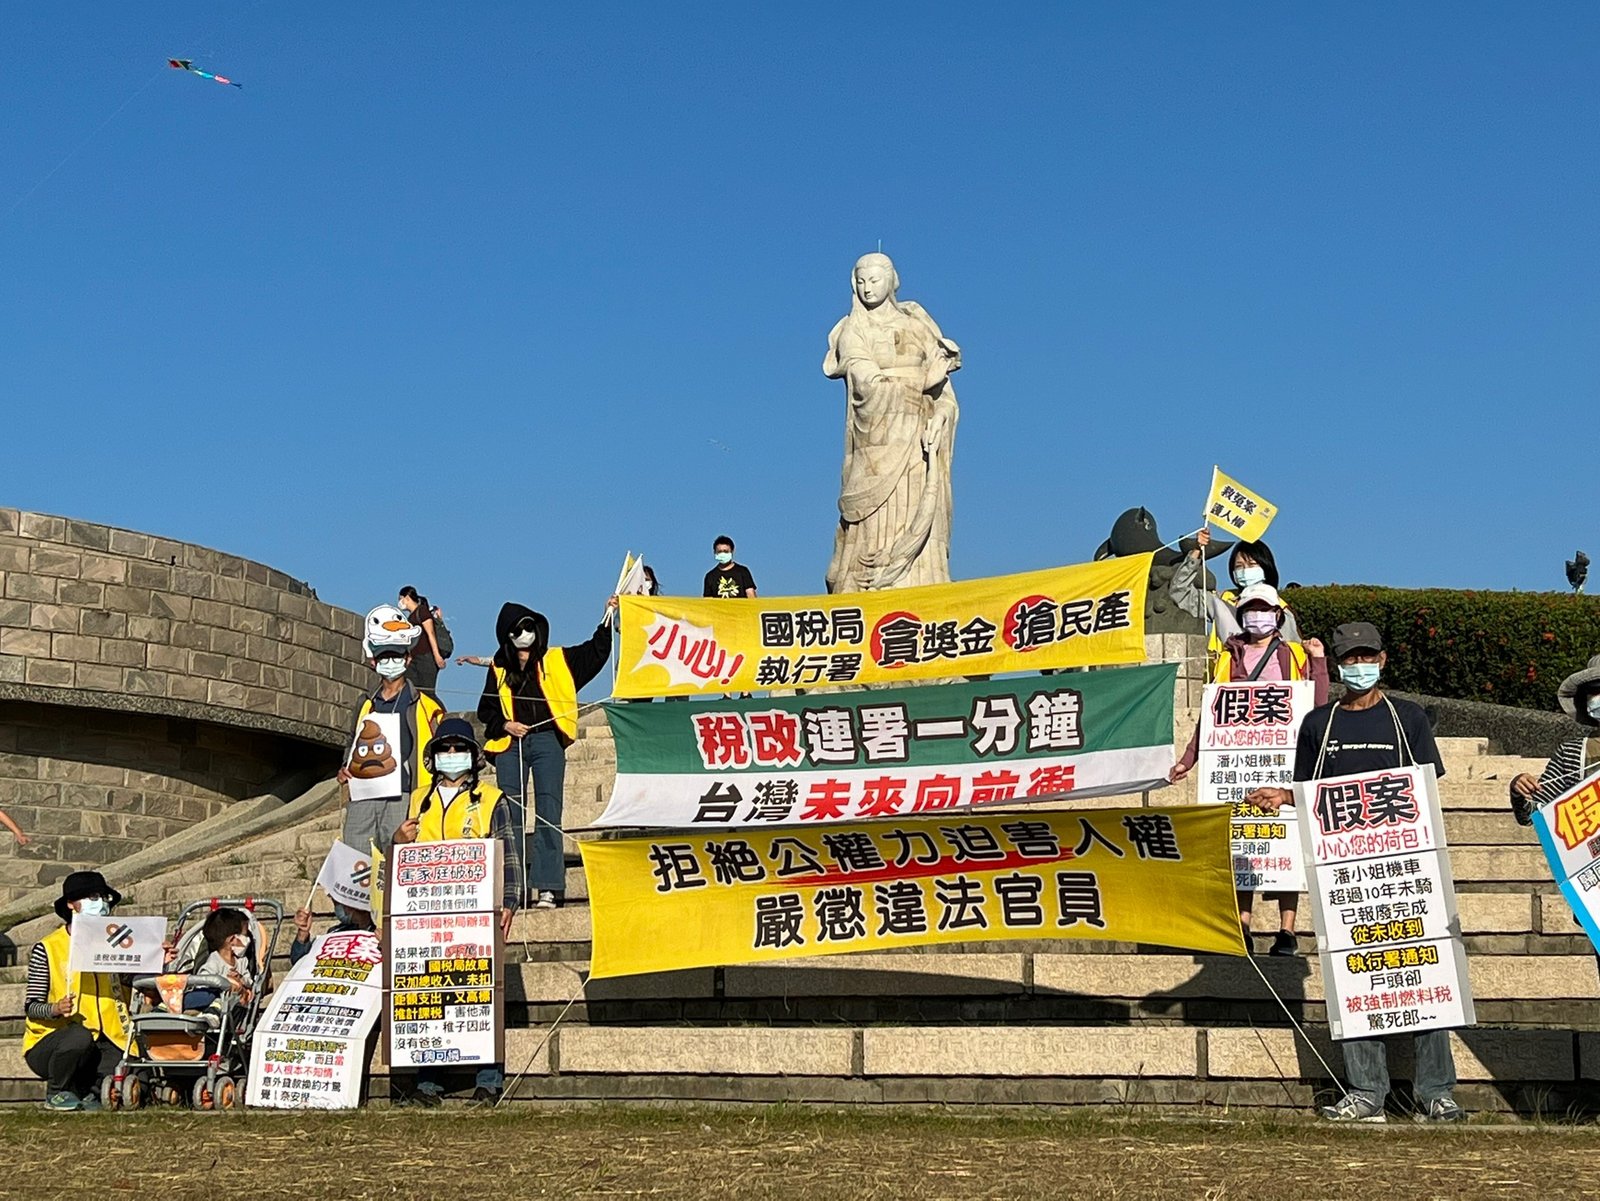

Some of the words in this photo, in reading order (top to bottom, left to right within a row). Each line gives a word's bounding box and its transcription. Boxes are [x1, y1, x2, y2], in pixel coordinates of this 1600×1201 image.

[761, 607, 864, 647] 國稅局
[1013, 591, 1131, 649] 搶民產
[756, 653, 862, 685] 執行署
[1213, 684, 1291, 726] 假案
[695, 691, 1083, 769] 稅改連署一分鐘
[1216, 753, 1286, 769] 潘小姐機車
[1209, 770, 1293, 784] 超過10年未騎
[1314, 774, 1419, 834] 假案
[400, 864, 484, 883] 害家庭破碎
[1333, 858, 1422, 886] 潘小姐機車
[406, 884, 478, 898] 優秀創業青年
[1329, 878, 1433, 906] 超過10年未騎
[754, 872, 1104, 948] 嚴懲違法官員
[1340, 899, 1429, 925] 已報廢完成
[1351, 917, 1424, 945] 從未收到
[1346, 945, 1439, 974] 執行署通知
[1370, 969, 1422, 991] 戶頭卻
